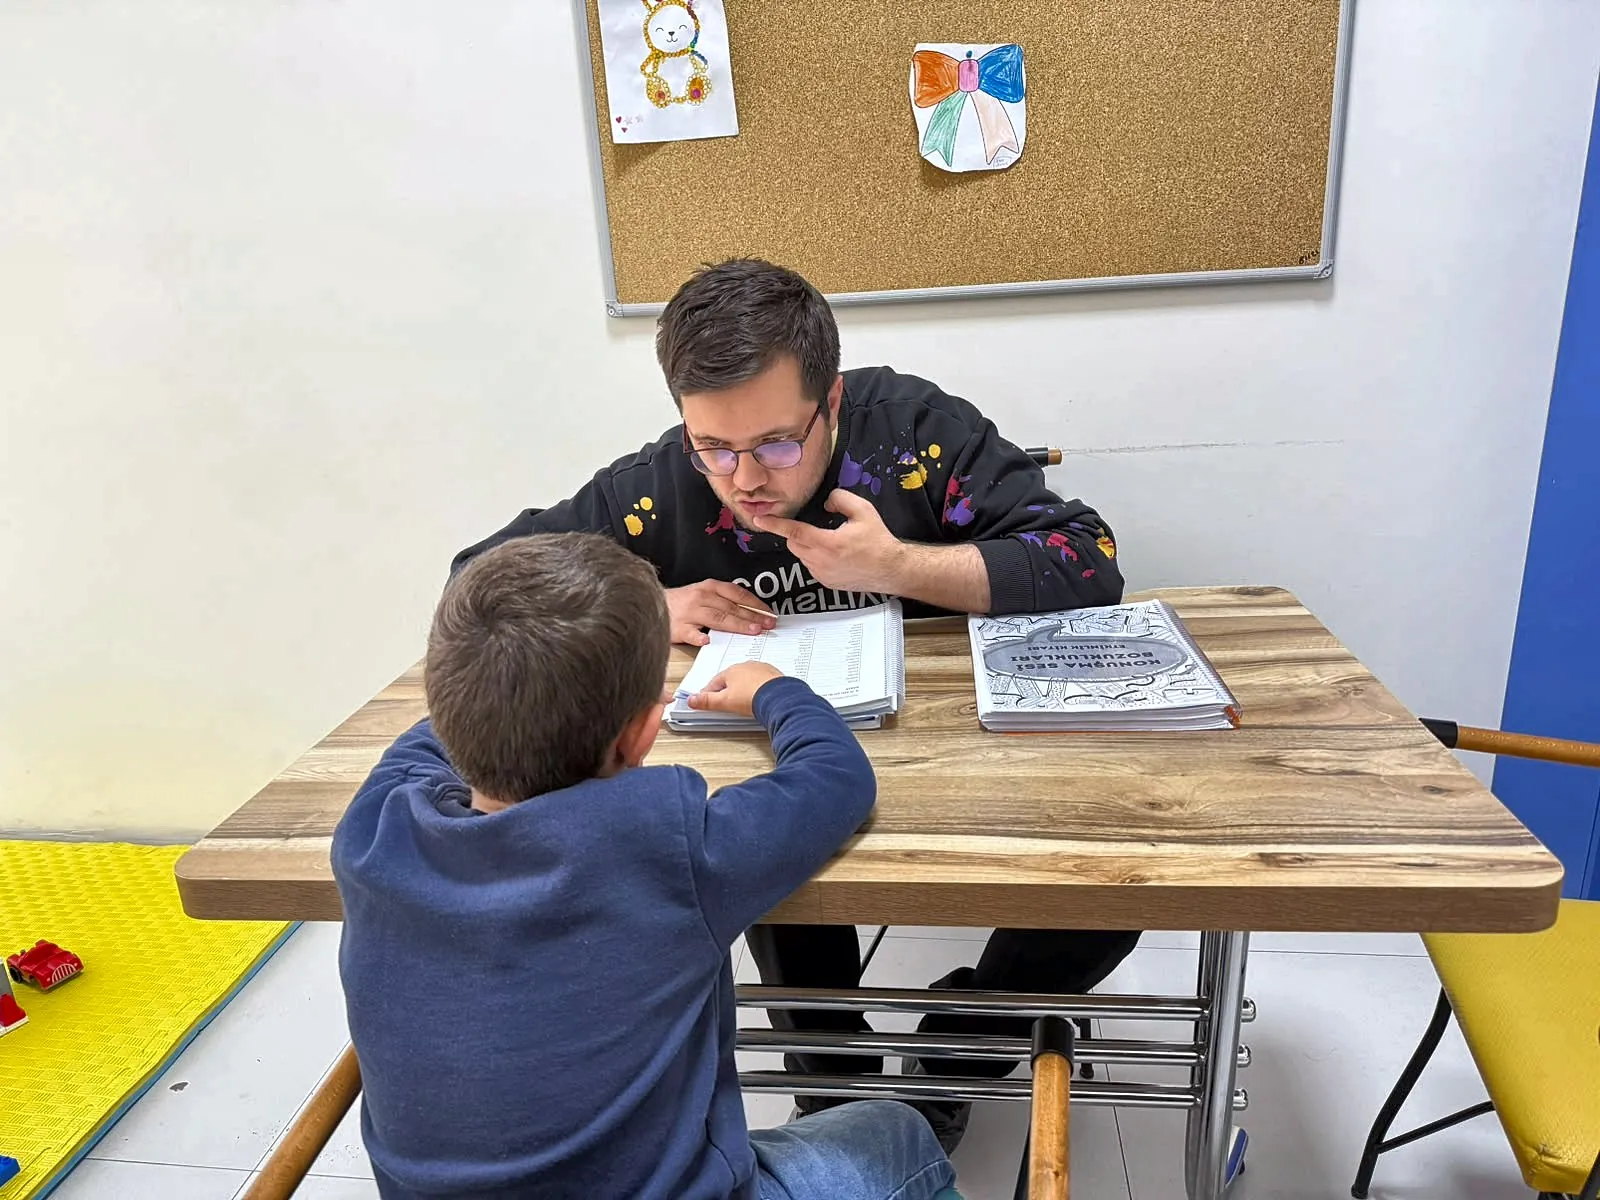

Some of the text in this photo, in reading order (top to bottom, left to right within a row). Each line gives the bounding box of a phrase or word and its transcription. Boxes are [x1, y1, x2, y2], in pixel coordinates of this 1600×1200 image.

[1010, 651, 1154, 661] BOZUKLUKLARI
[1016, 659, 1161, 671] KONUŞMA SESİ
